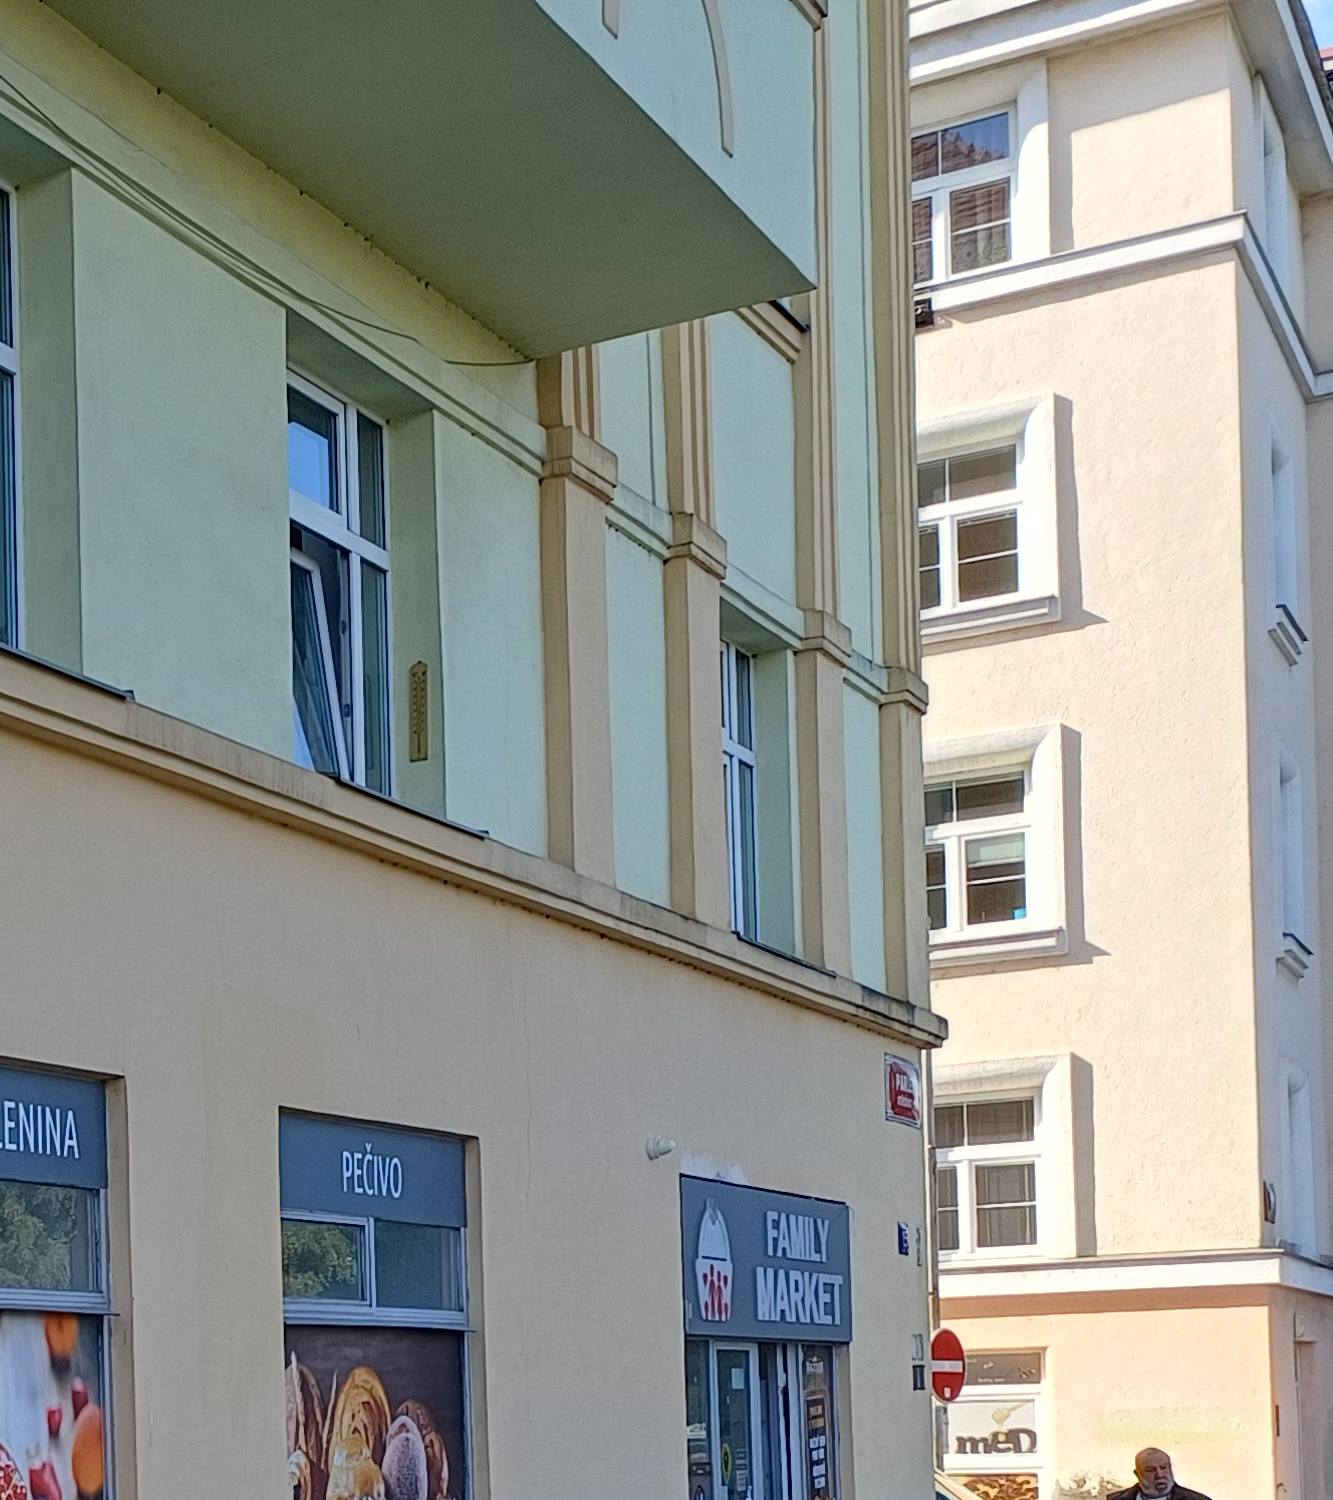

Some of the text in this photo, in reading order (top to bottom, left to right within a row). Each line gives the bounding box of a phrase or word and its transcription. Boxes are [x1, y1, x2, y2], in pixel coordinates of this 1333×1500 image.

[342, 1142, 403, 1199] PEČIVO
[766, 1210, 830, 1263] FAMILY
[756, 1266, 844, 1326] MARKET
